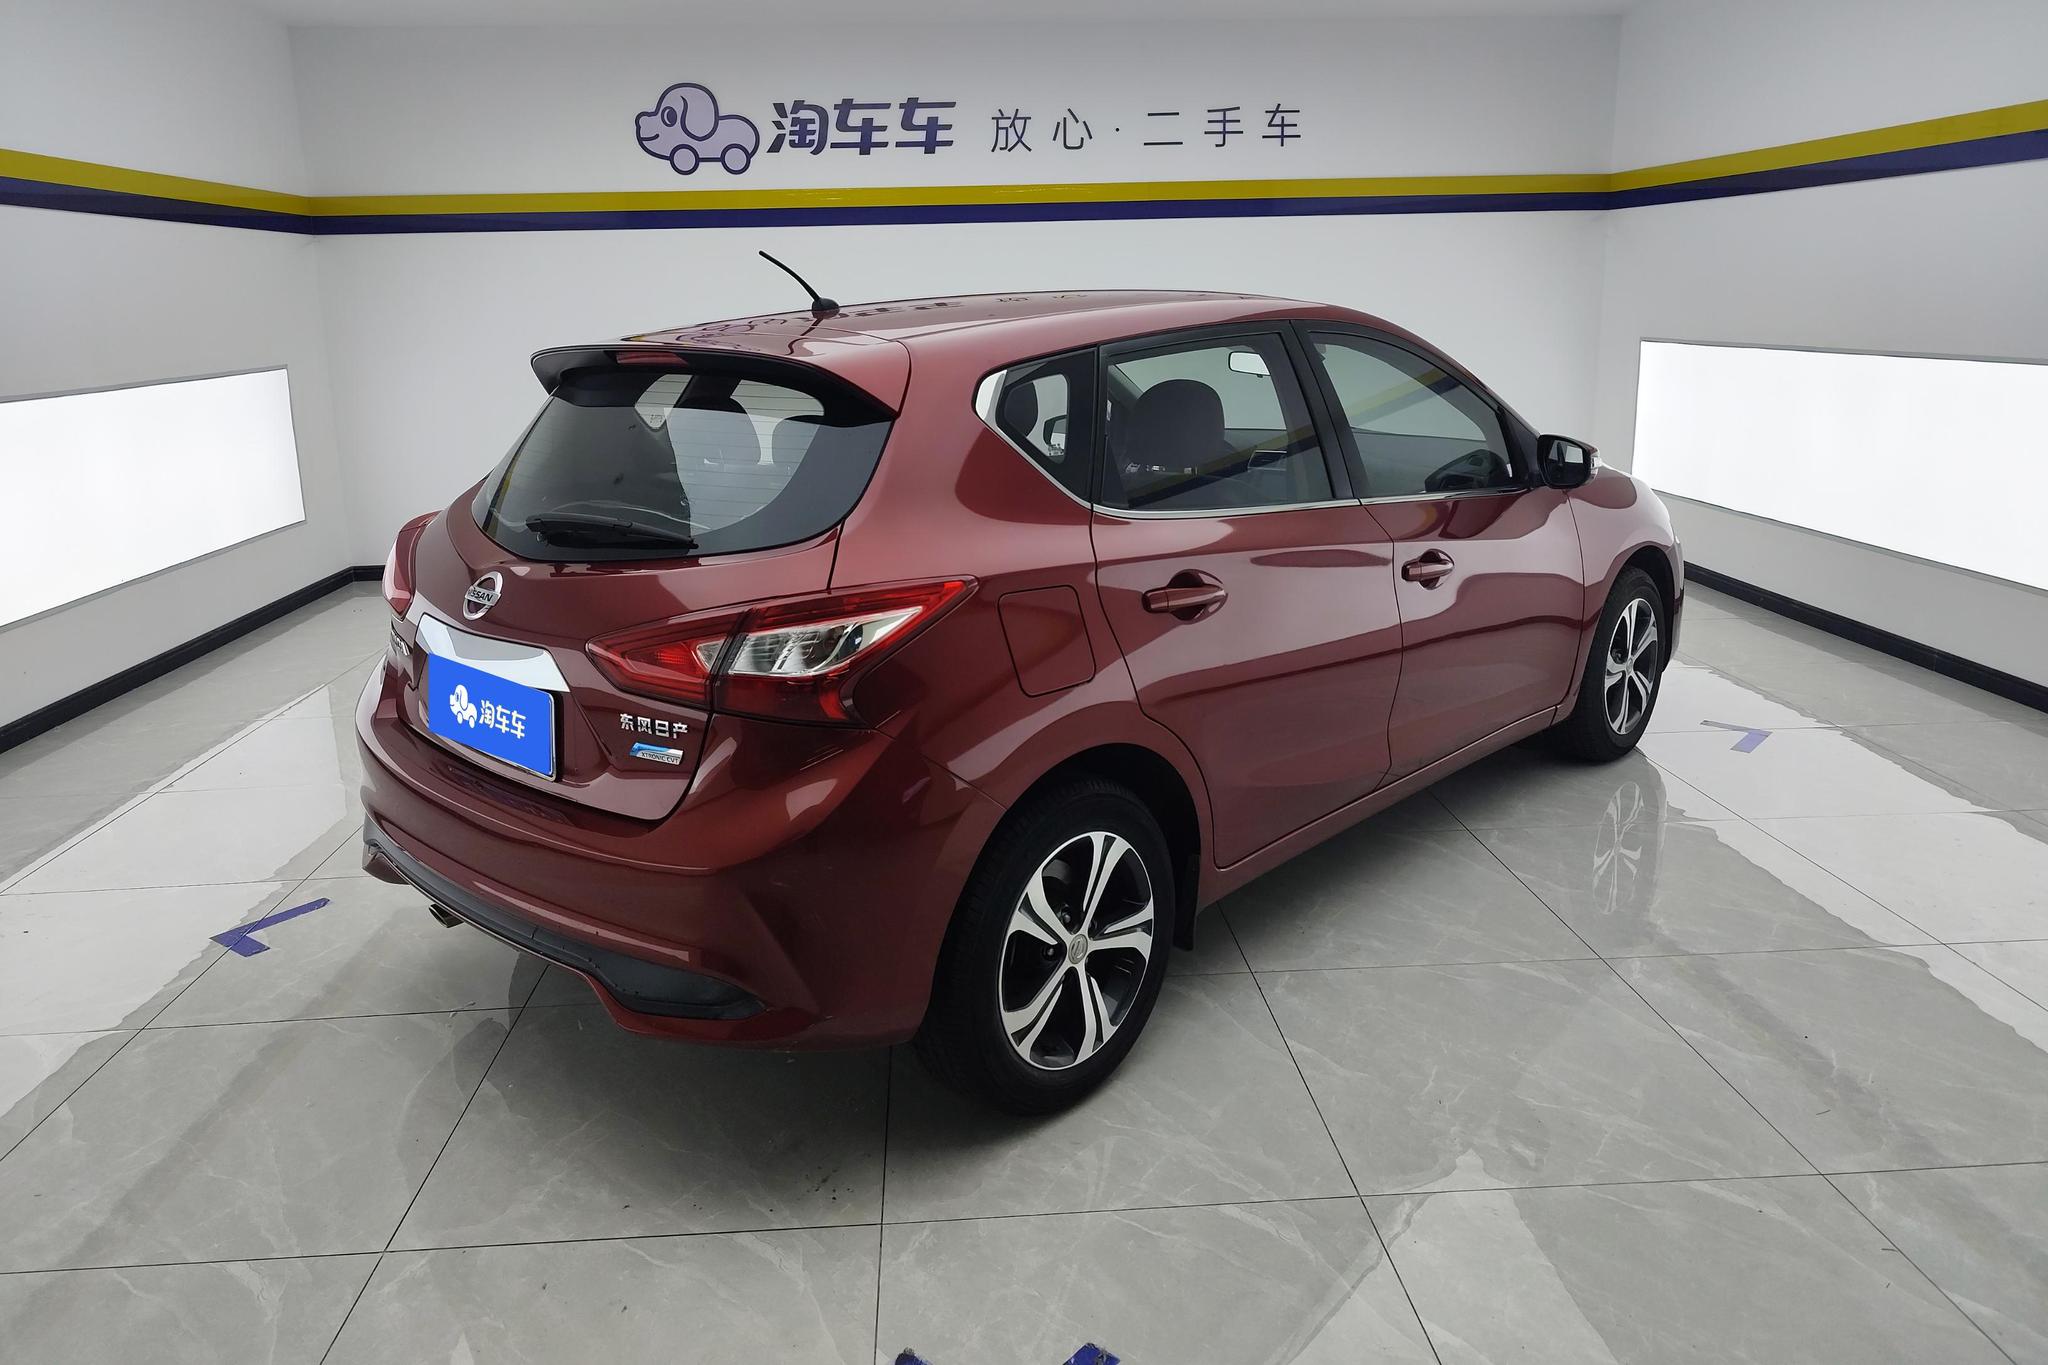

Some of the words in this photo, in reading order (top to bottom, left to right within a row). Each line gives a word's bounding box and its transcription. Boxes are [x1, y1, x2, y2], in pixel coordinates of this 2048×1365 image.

[767, 98, 956, 154] 淘车车
[620, 713, 688, 739] 东风日产
